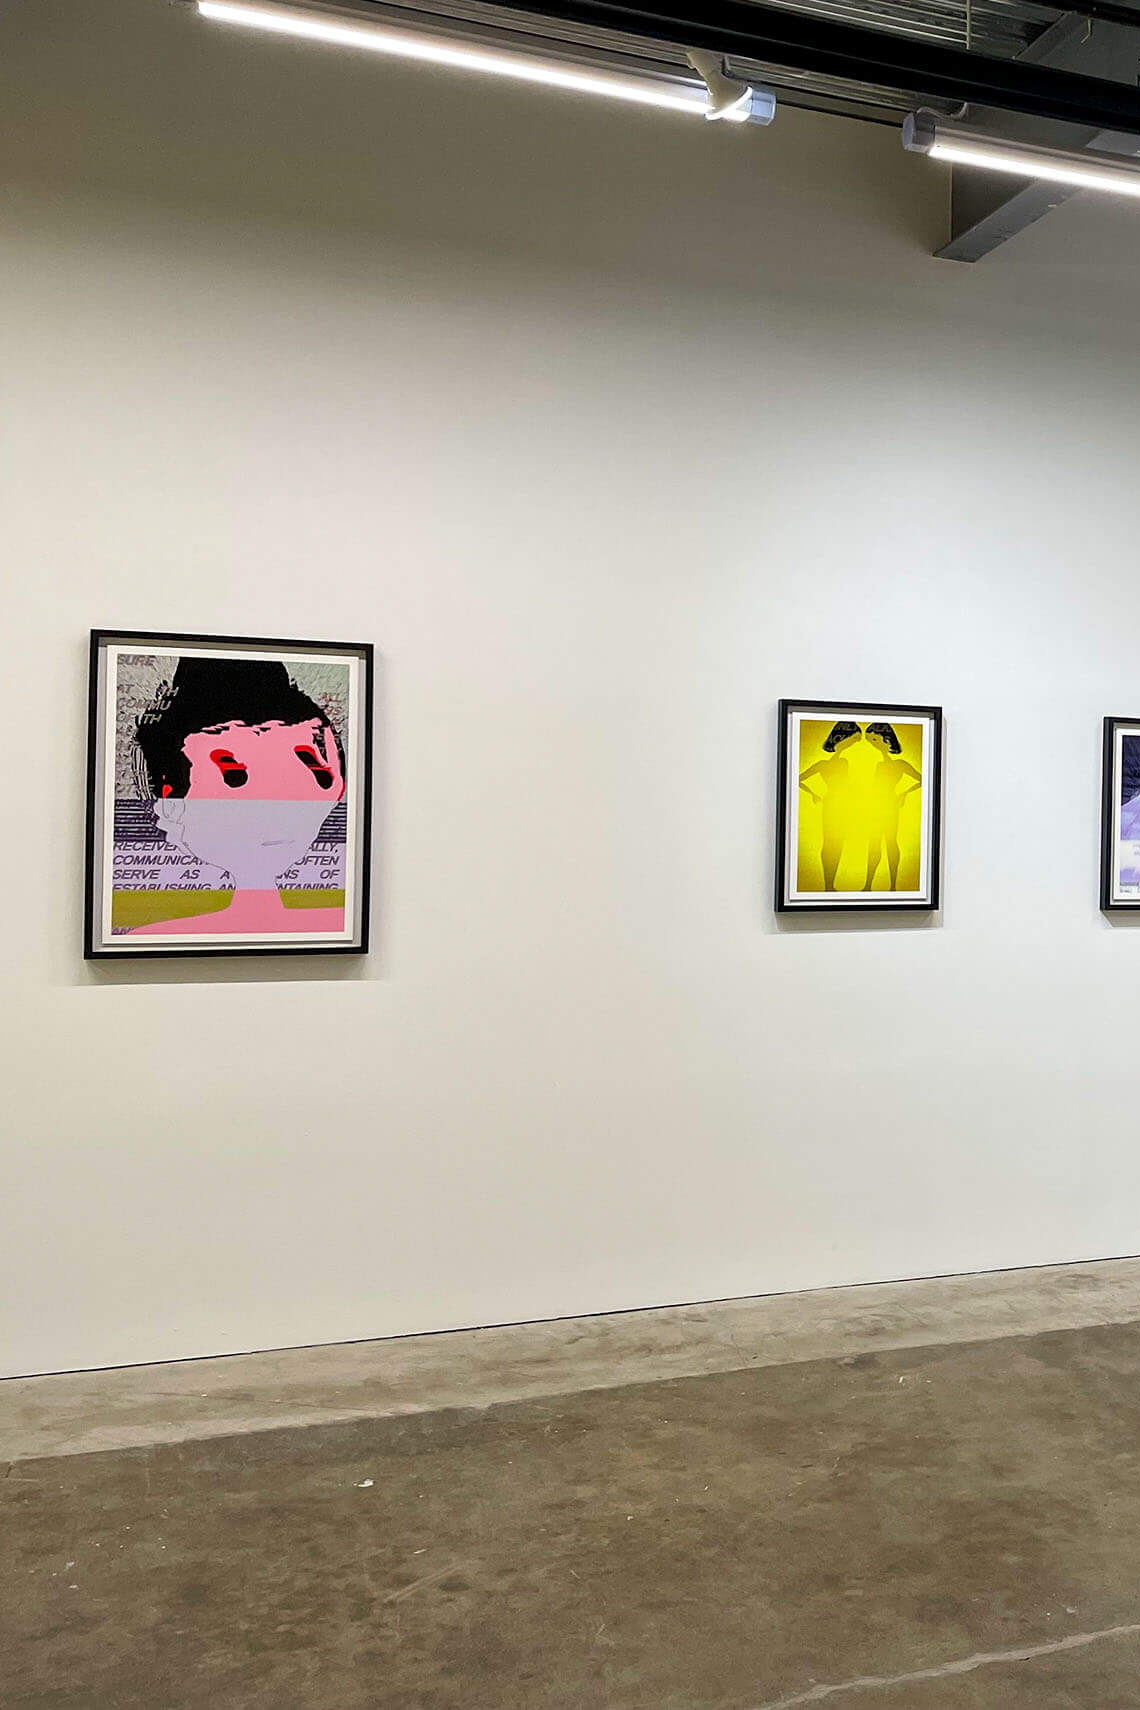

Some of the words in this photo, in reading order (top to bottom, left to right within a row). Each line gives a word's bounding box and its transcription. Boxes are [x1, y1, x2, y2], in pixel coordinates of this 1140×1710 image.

[112, 869, 161, 880] SERVE
[180, 869, 201, 880] AS
[320, 869, 340, 879] OF
